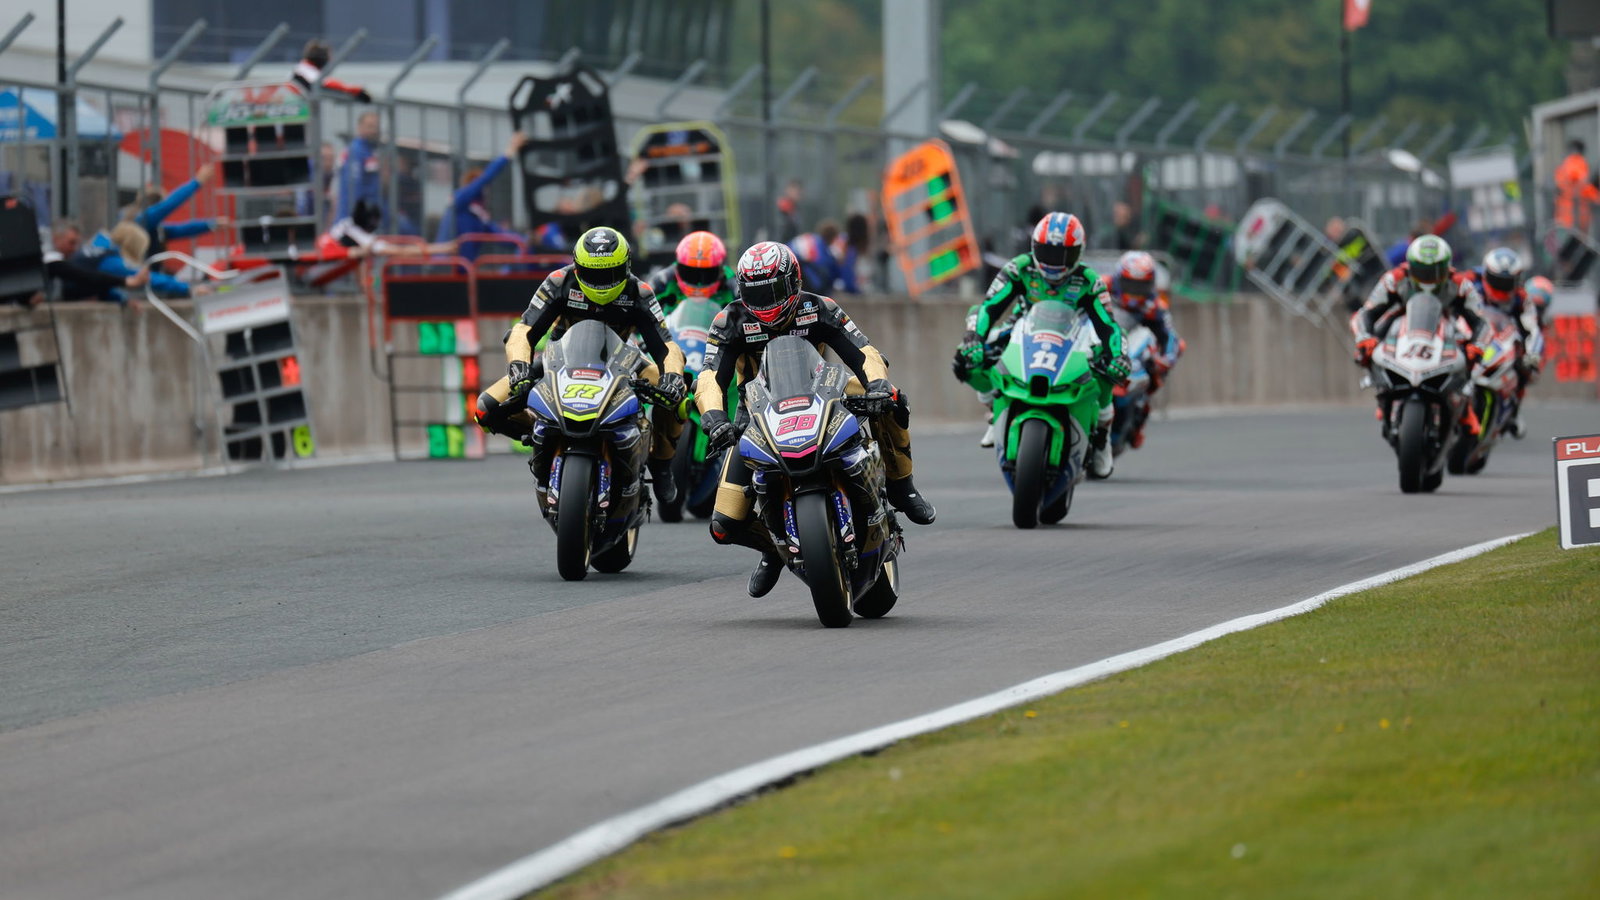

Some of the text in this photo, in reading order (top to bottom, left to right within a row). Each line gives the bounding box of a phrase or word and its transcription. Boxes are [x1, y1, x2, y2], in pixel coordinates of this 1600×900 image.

[747, 268, 772, 276] SHARK
[1029, 351, 1058, 371] 11
[562, 384, 604, 399] 77
[776, 414, 818, 436] 28
[825, 409, 844, 433] RICH
[746, 426, 768, 445] RICH
[1565, 442, 1600, 456] PL
